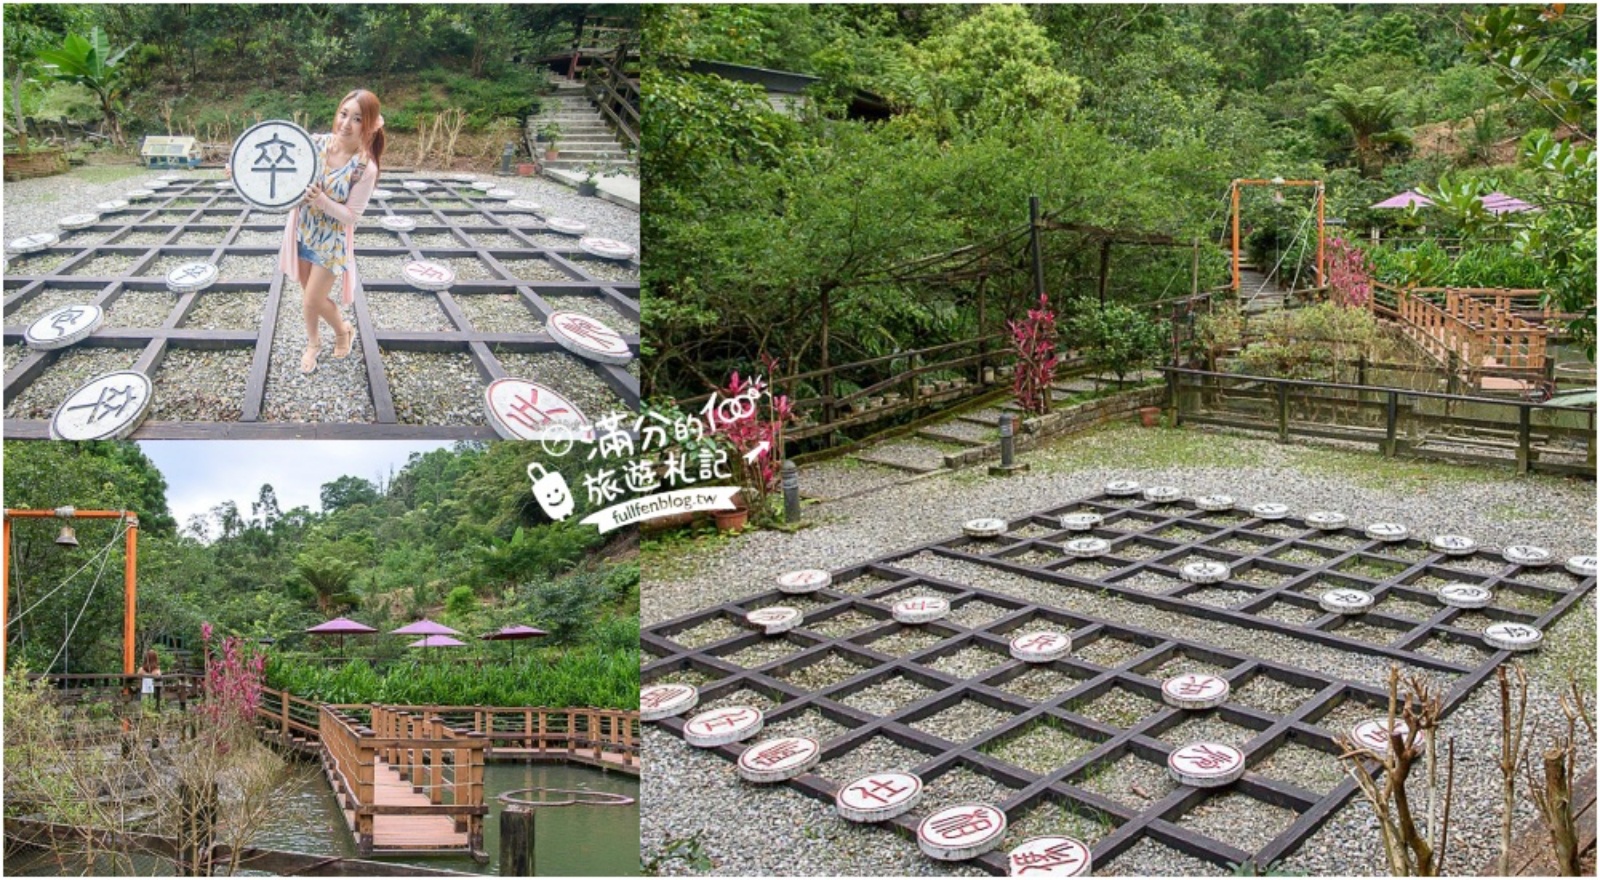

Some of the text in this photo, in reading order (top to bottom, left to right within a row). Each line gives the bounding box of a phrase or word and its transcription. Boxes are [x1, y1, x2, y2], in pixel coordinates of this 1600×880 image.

[251, 133, 297, 198] 卒
[67, 385, 137, 424] 卒
[849, 779, 909, 803] 仕
